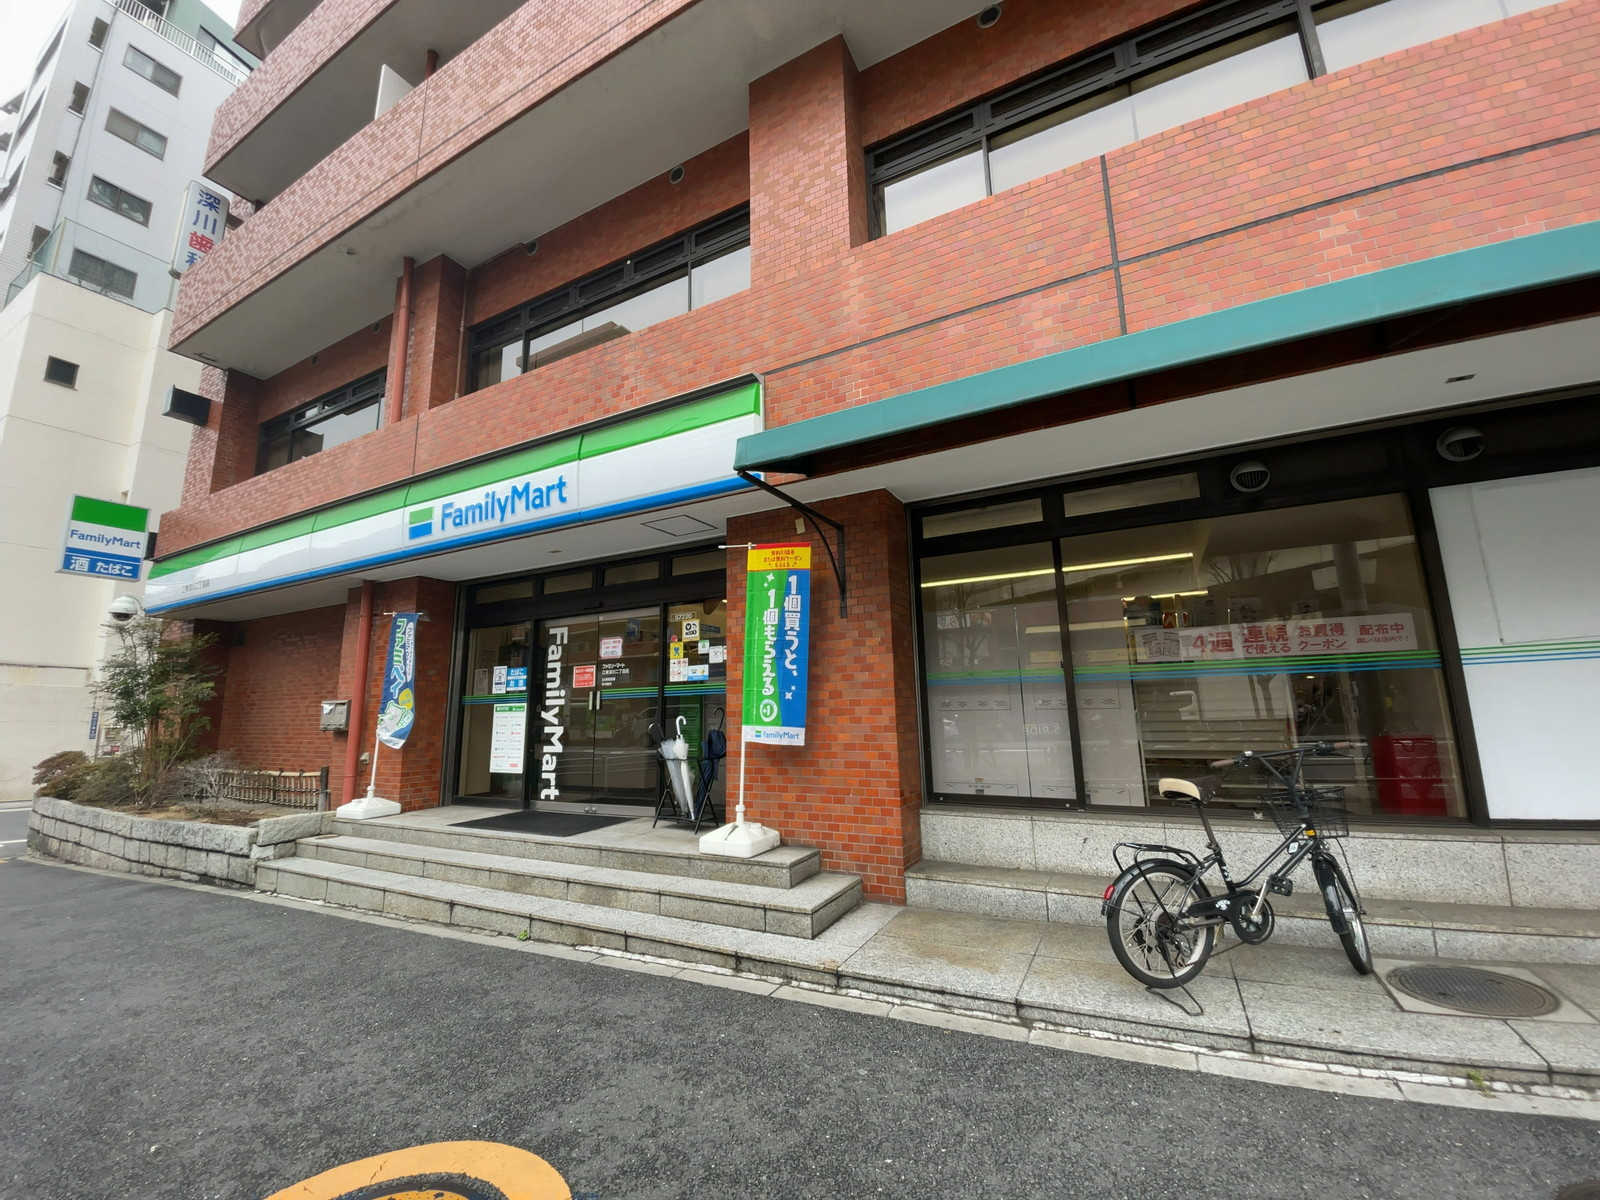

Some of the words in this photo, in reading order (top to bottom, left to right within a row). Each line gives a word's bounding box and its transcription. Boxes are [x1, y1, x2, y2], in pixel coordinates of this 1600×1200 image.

[440, 475, 566, 531] FamilyMart
[70, 529, 142, 549] FamilyMart
[69, 555, 90, 572] 酒
[95, 561, 133, 576] たばこ
[783, 574, 801, 678] 1個買うと、
[1358, 622, 1405, 637] 配布中
[762, 589, 779, 697] 1個もらえる
[1242, 642, 1291, 656] で使える
[1298, 639, 1347, 652] クーポン
[540, 626, 568, 800] FamilyMart
[763, 731, 800, 740] FamilyMart
